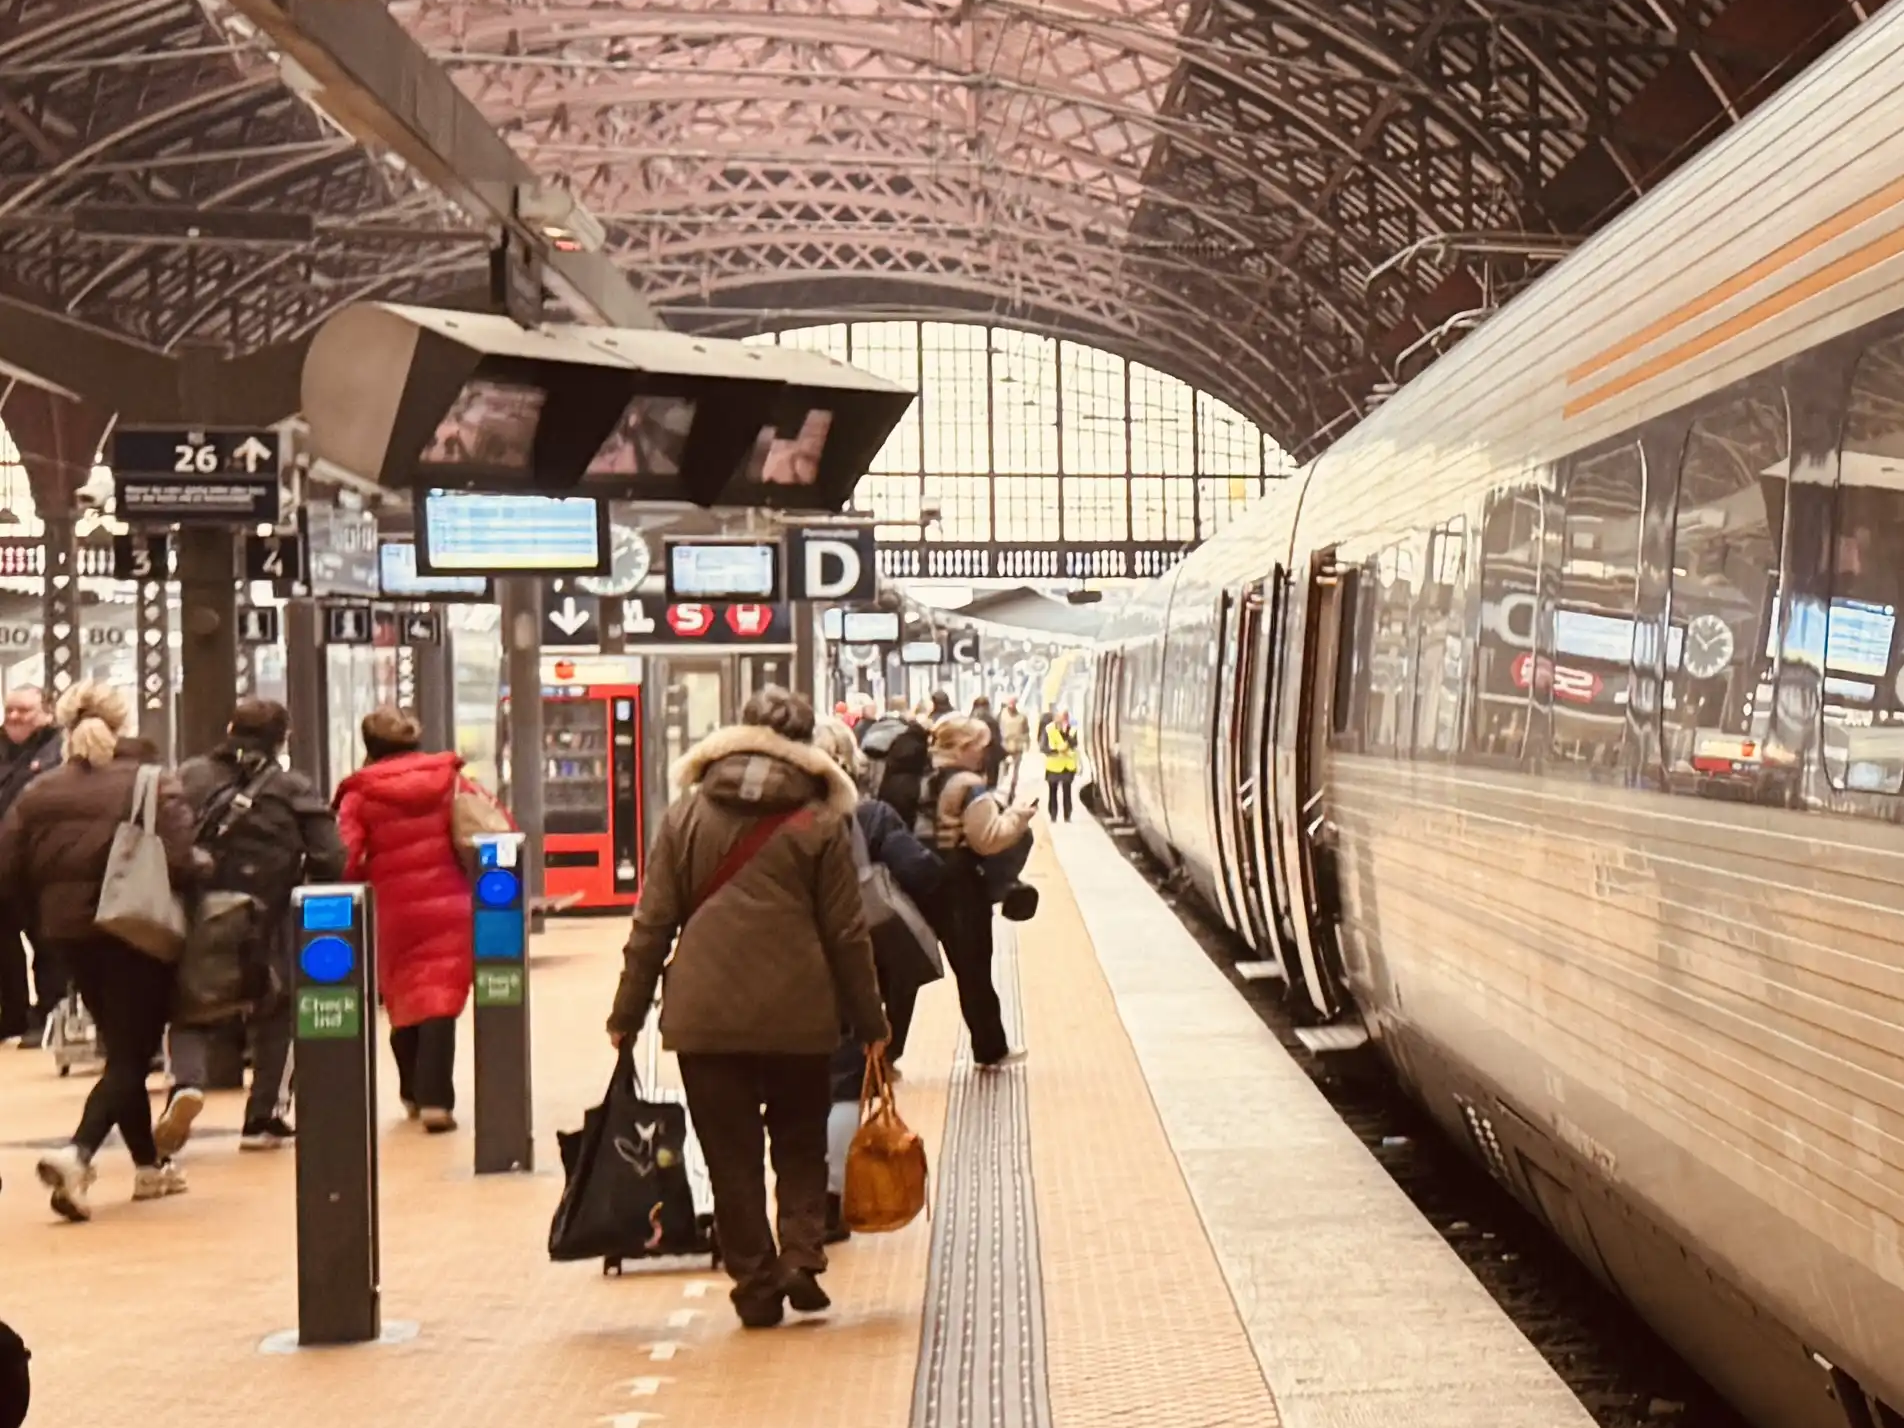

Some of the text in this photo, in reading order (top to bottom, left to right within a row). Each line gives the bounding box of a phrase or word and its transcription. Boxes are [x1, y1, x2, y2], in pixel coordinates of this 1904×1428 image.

[174, 444, 218, 473] 26
[131, 549, 152, 576] 3
[262, 548, 284, 577] 4
[804, 539, 861, 599] D
[676, 603, 704, 630] S
[953, 638, 976, 664] C
